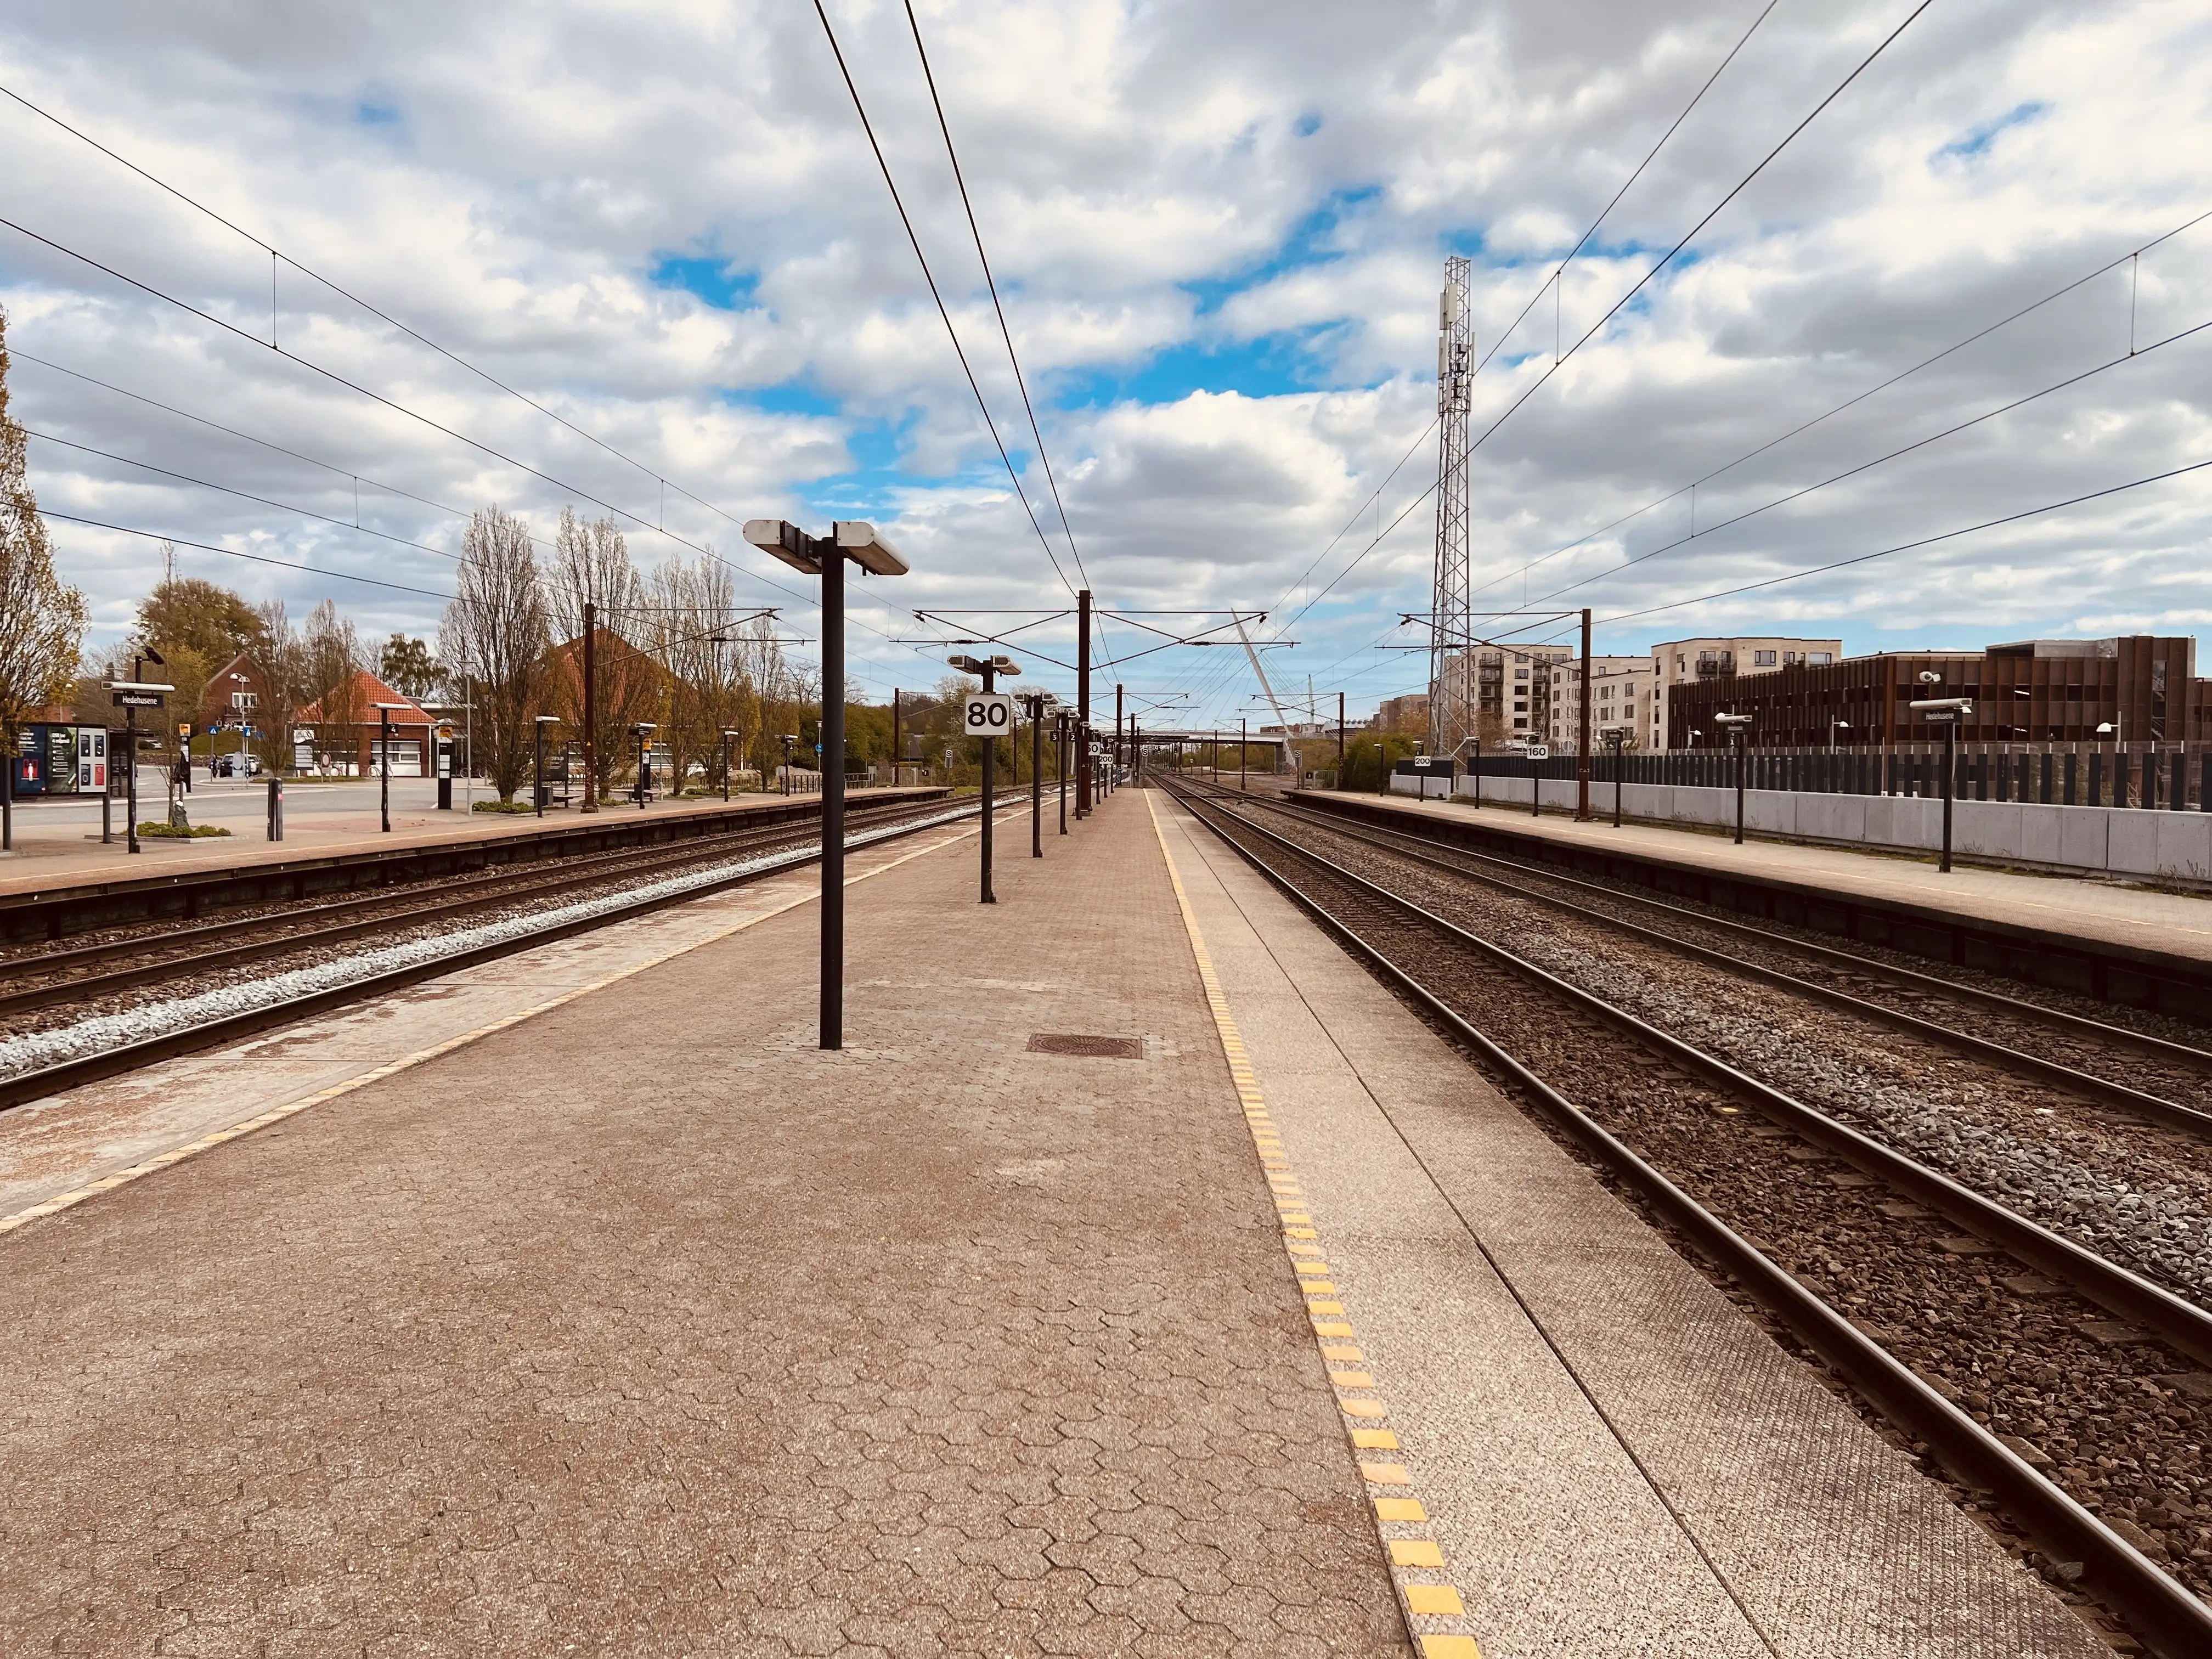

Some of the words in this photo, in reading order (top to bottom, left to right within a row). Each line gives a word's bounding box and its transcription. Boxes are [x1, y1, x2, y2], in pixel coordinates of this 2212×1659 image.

[122, 696, 157, 704] Hedehusene
[967, 702, 1007, 727] 80
[1528, 747, 1546, 756] 160
